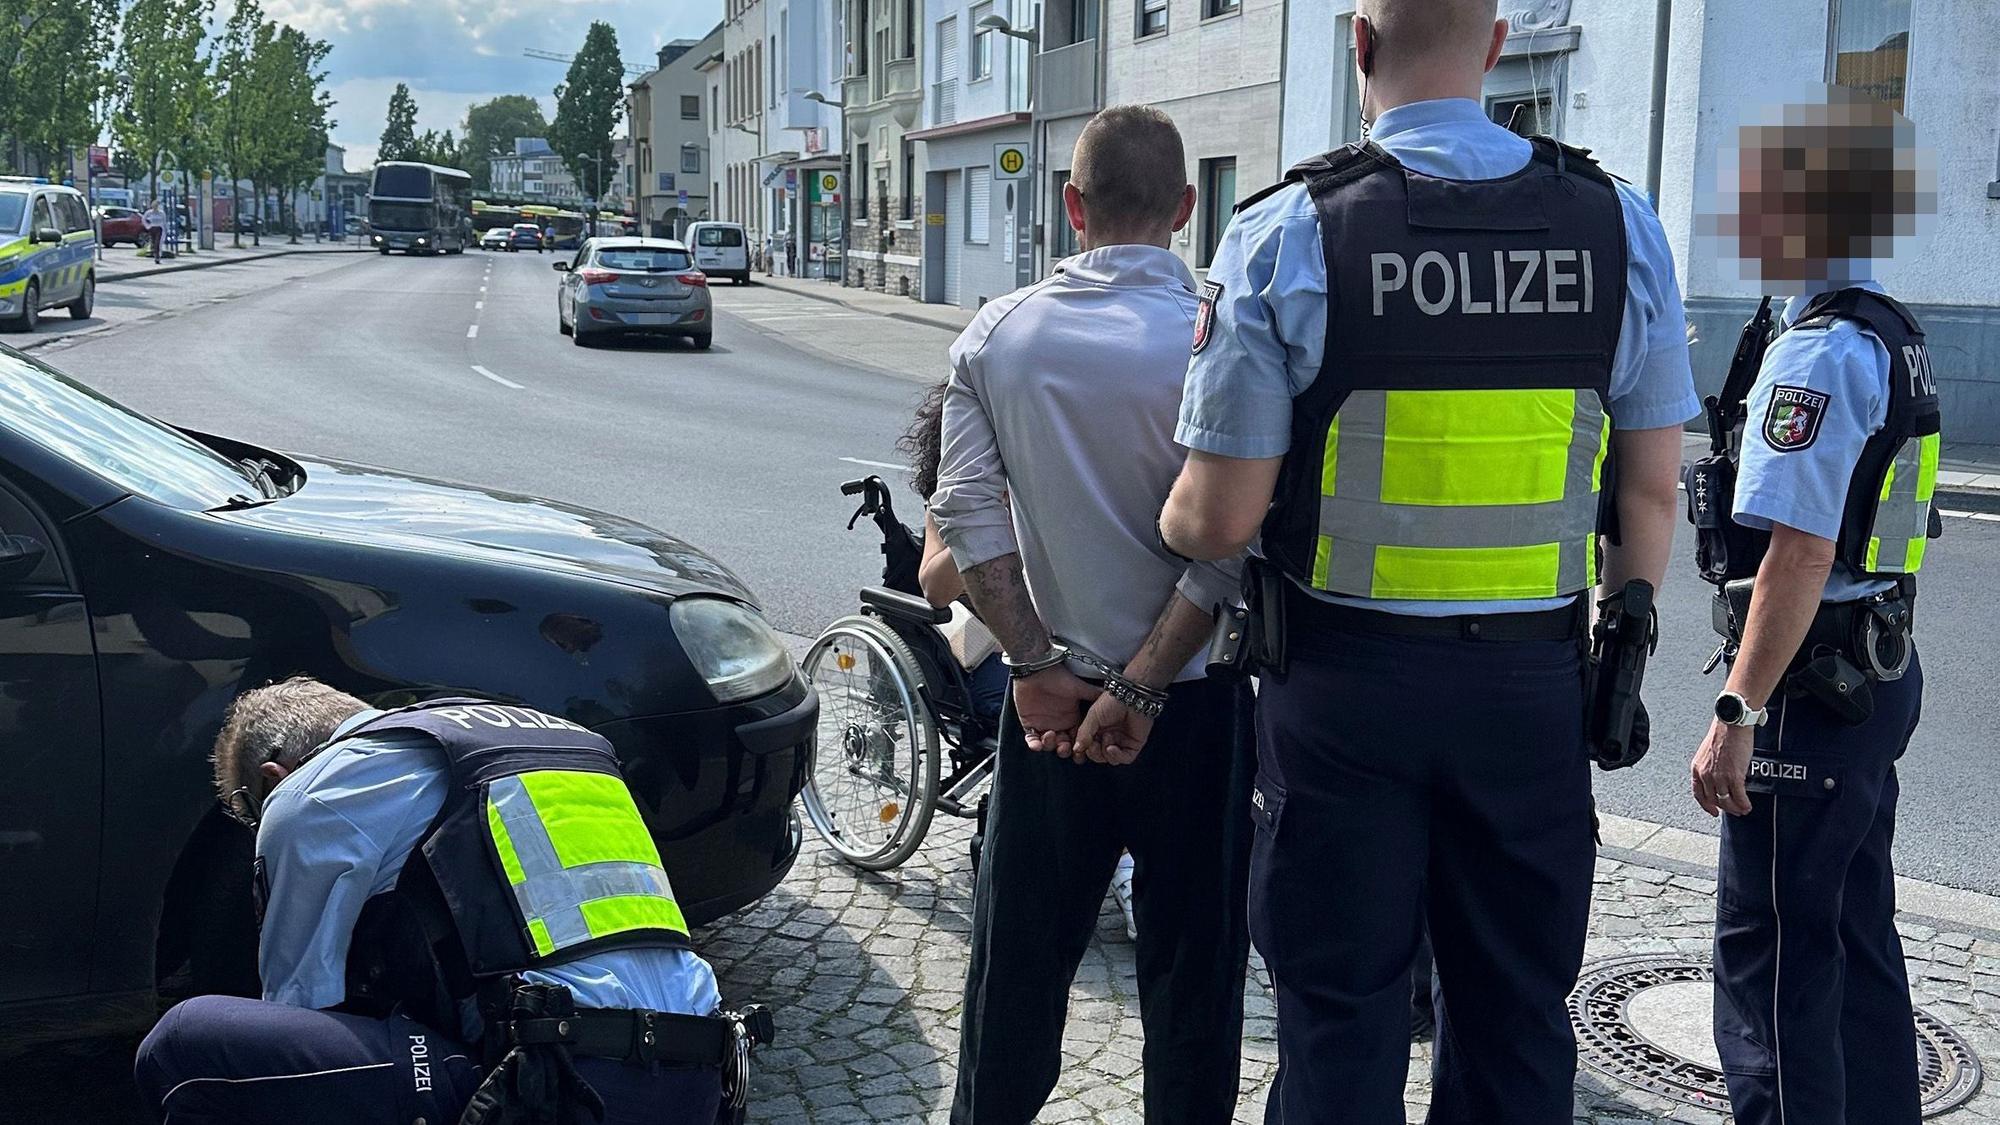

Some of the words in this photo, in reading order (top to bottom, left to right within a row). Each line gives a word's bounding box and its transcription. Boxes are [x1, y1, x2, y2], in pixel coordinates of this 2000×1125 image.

[1007, 154, 1017, 169] H
[1370, 249, 1594, 316] POLIZEI
[1776, 391, 1823, 409] POLIZEI
[1751, 760, 1807, 780] POLIZEI
[408, 1035, 432, 1092] POLIZEI
